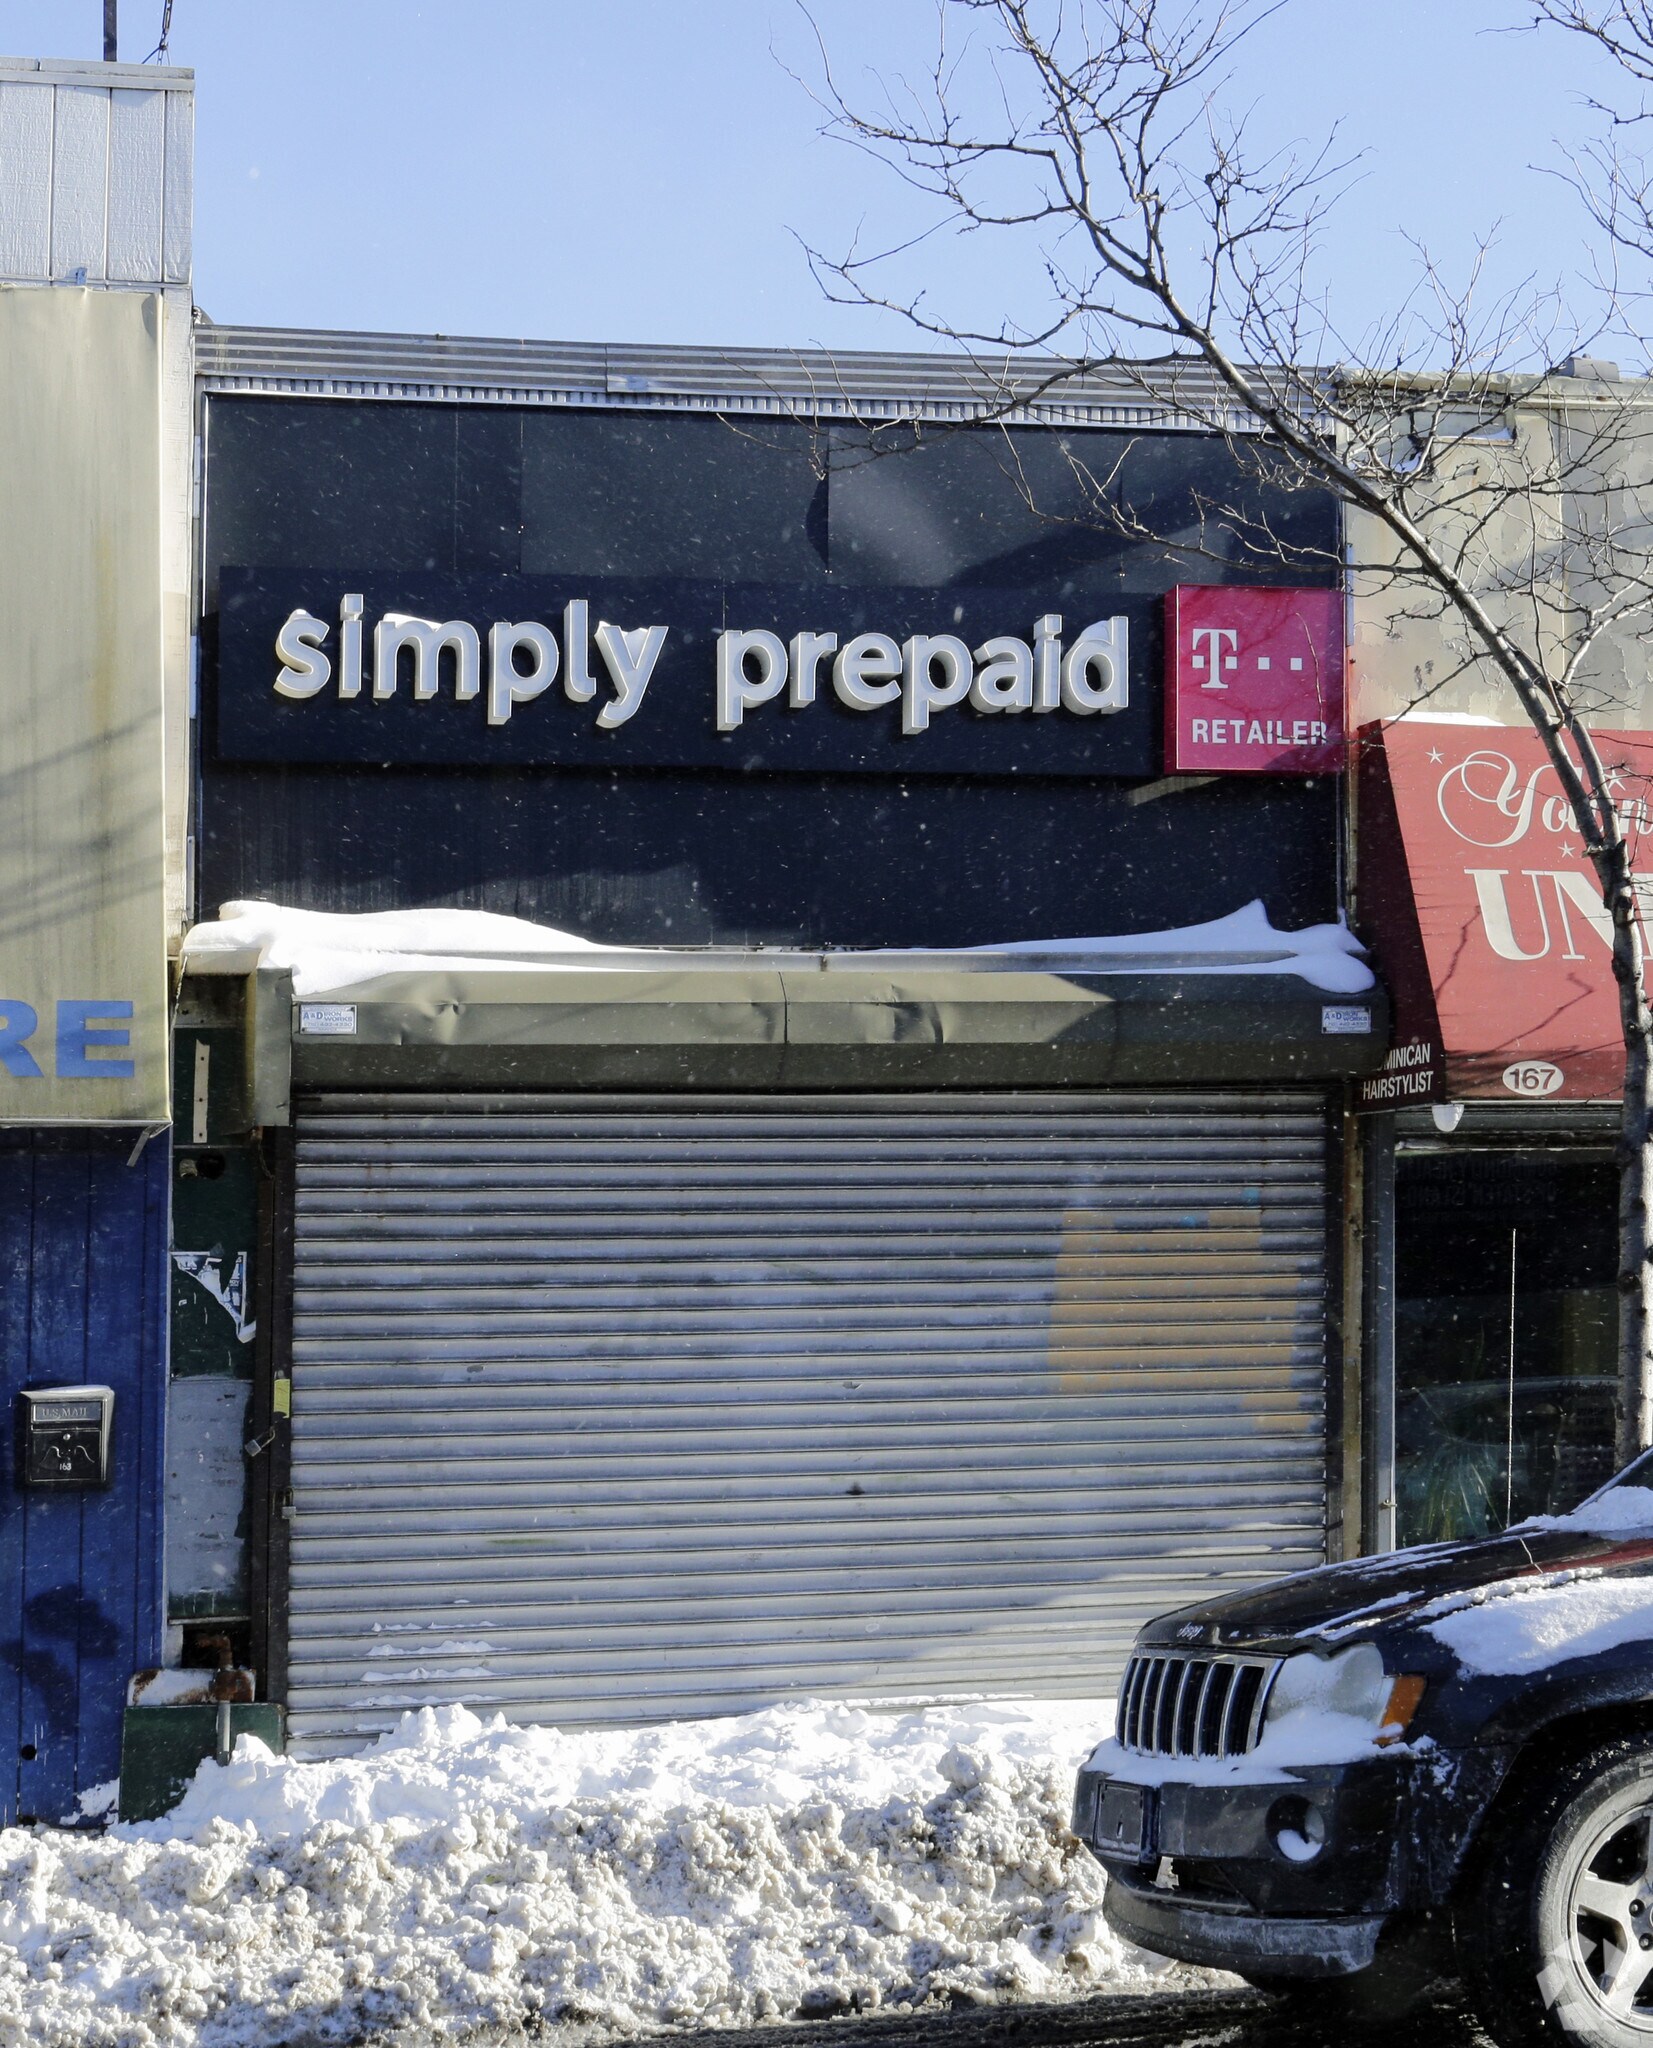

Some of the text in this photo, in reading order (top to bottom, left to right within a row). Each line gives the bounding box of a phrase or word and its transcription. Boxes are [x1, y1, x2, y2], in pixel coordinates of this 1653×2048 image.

[273, 594, 1129, 734] simply prepaid
[1192, 718, 1327, 745] RETAILER
[1384, 1043, 1431, 1070] MINICAN
[1363, 1071, 1434, 1101] HAIRSTYLIST
[1509, 1068, 1556, 1090] 167
[59, 1462, 72, 1472] 163
